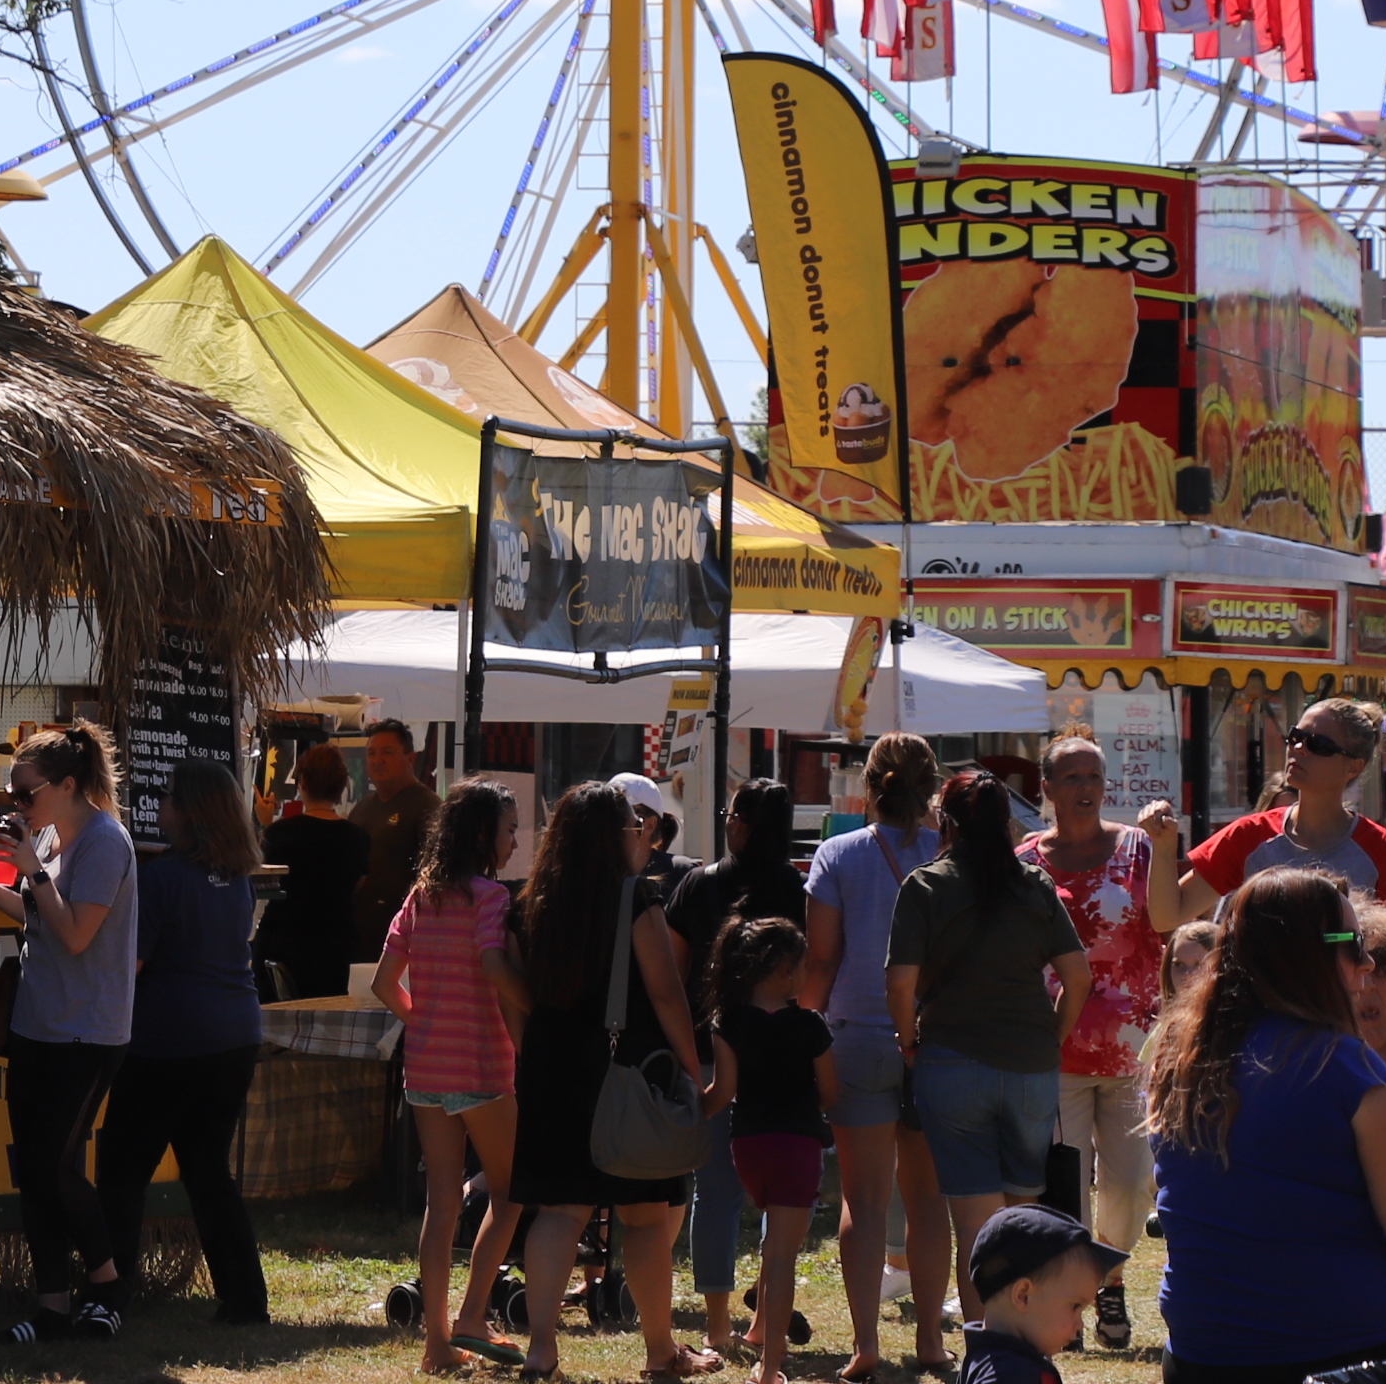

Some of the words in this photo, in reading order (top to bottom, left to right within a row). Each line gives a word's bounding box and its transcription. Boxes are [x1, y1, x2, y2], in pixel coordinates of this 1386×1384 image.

[770, 82, 813, 235] cinnamon
[892, 177, 1159, 227] ICKEN
[899, 220, 1171, 273] NDERS
[799, 244, 830, 335] donut
[813, 345, 830, 438] treats
[733, 547, 797, 589] cinnamon
[800, 543, 841, 592] donut
[945, 606, 976, 631] ON
[982, 606, 999, 631] A
[1003, 606, 1069, 632] STICK
[1206, 597, 1299, 622] CHICKEN
[1213, 619, 1293, 640] WRAPS
[1118, 723, 1155, 736] KEEP
[154, 746, 159, 756] a
[161, 744, 186, 759] Twist
[1114, 739, 1159, 752] CALM
[1122, 763, 1151, 776] EAT
[1105, 779, 1170, 793] CHCKEN
[138, 795, 160, 811] Che
[1122, 796, 1133, 807] A
